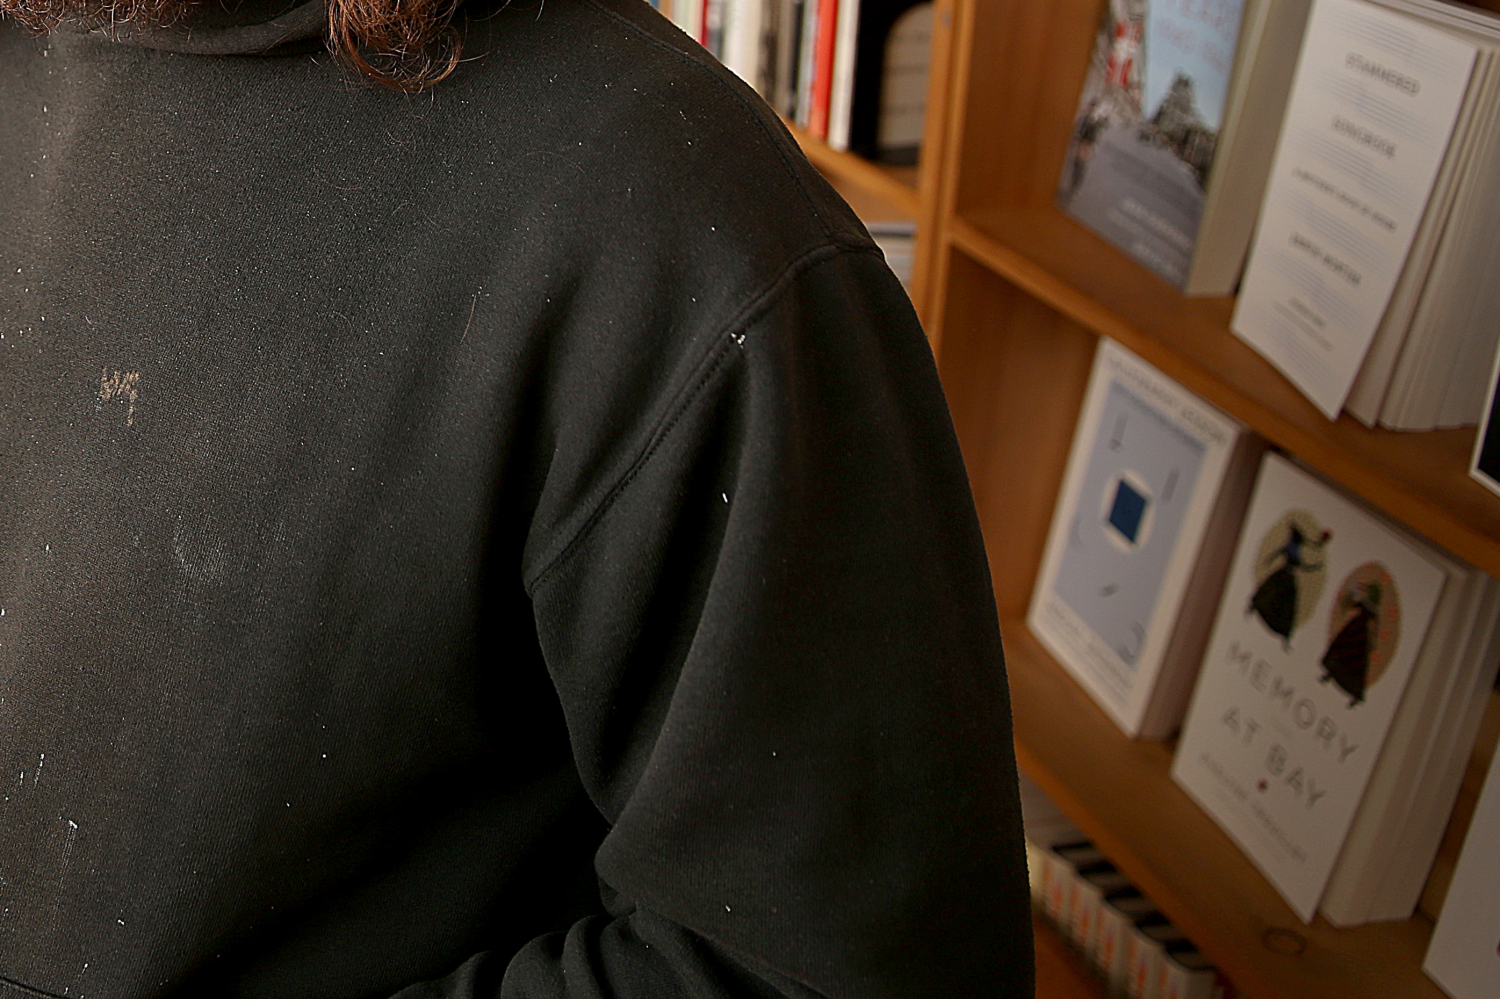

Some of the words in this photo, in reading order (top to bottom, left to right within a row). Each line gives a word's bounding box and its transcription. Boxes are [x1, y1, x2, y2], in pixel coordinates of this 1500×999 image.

[1220, 704, 1264, 748] AT
[1264, 741, 1327, 811] BAY
[1224, 640, 1360, 766] MEMORY
